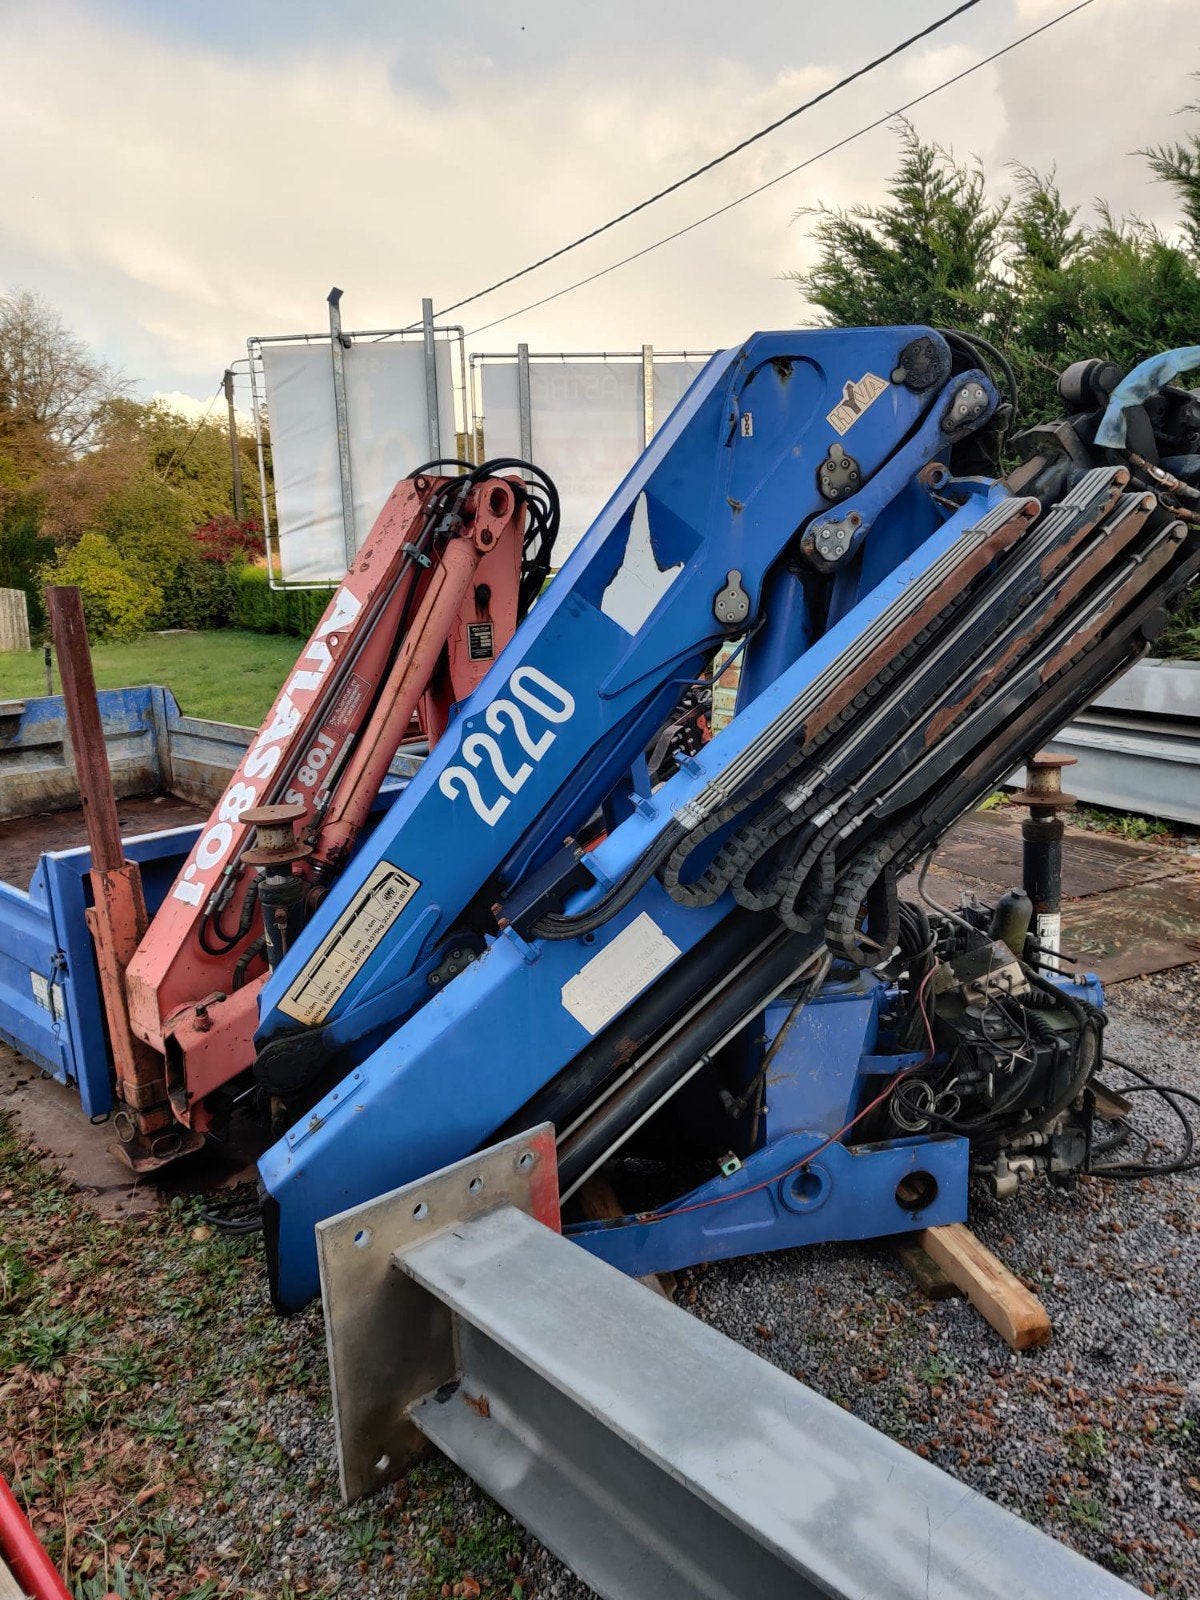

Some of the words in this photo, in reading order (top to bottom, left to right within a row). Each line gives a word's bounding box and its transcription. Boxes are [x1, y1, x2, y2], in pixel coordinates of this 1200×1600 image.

[829, 375, 886, 433] HYVA
[244, 586, 362, 779] ATLAS
[297, 731, 336, 787] 80.1
[438, 666, 576, 827] 220
[172, 781, 257, 907] 80.1
[384, 887, 396, 902] HMF
